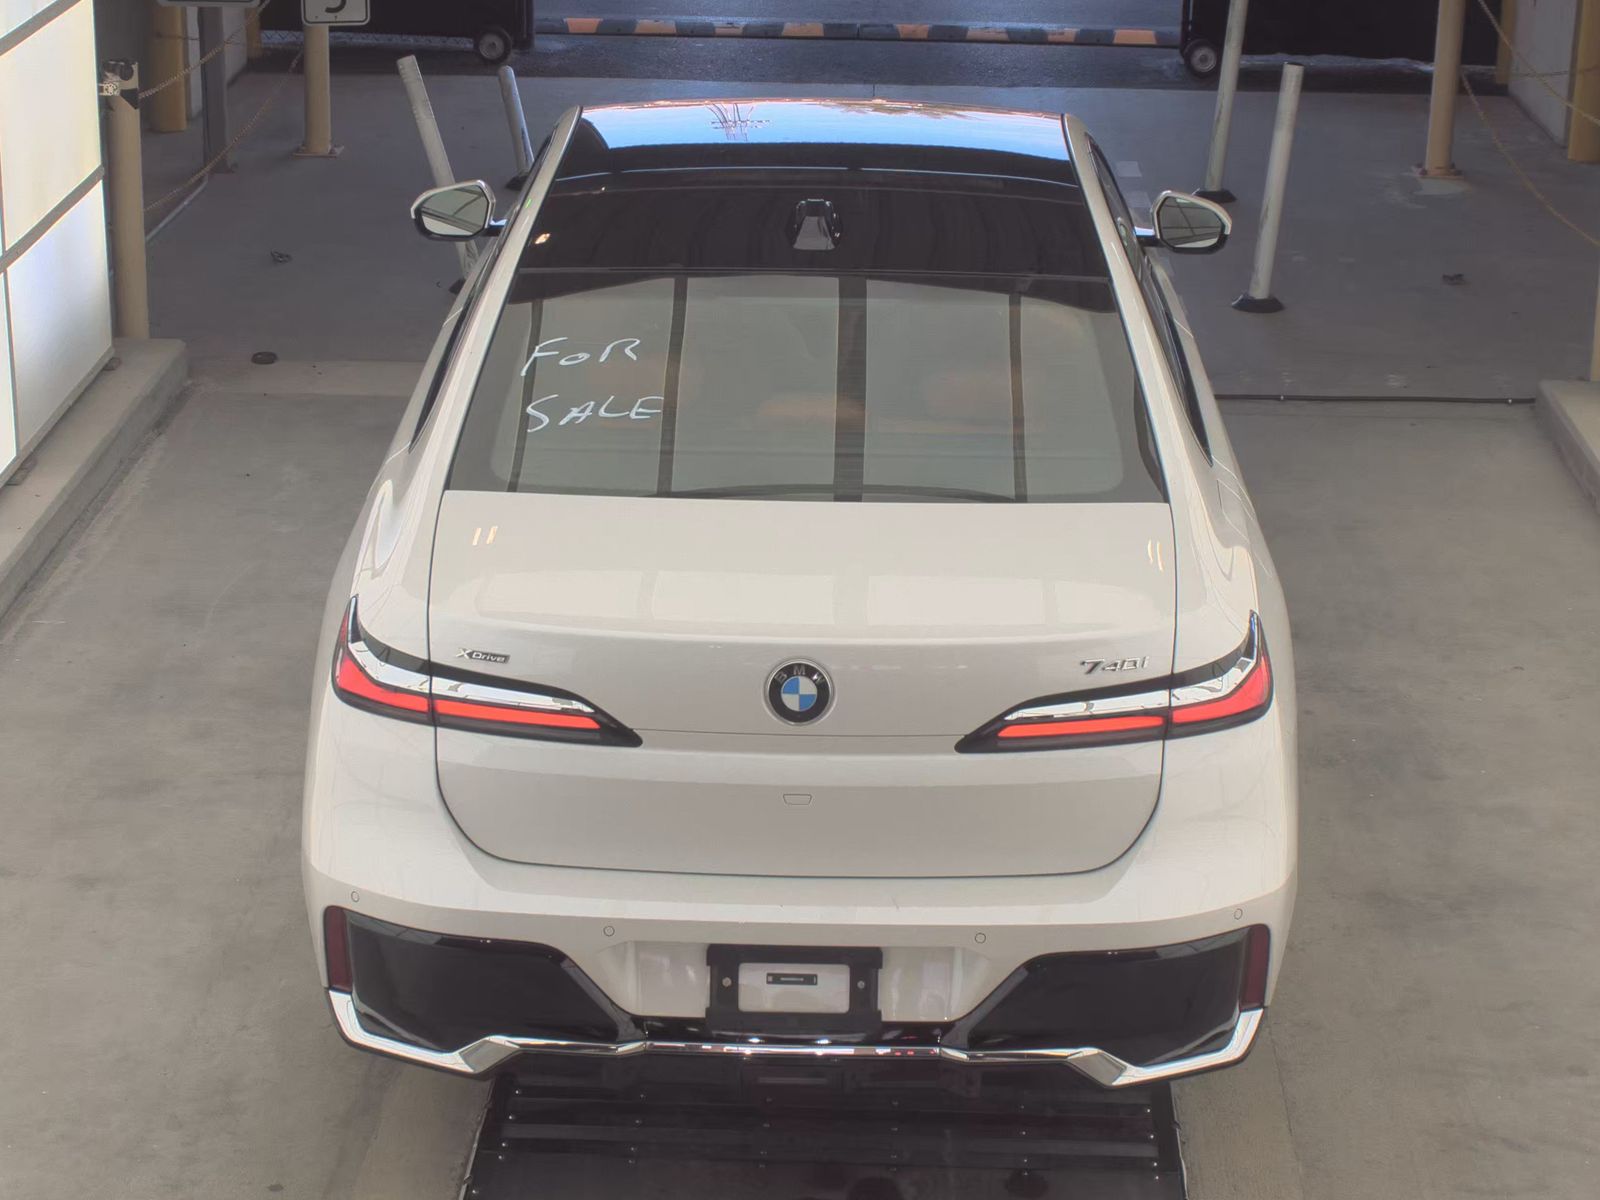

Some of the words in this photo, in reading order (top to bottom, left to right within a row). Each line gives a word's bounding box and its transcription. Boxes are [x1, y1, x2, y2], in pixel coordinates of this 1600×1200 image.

[520, 336, 640, 376] FOR
[526, 394, 664, 432] SALE
[774, 664, 825, 685] BMW
[1080, 656, 1149, 674] 740i
